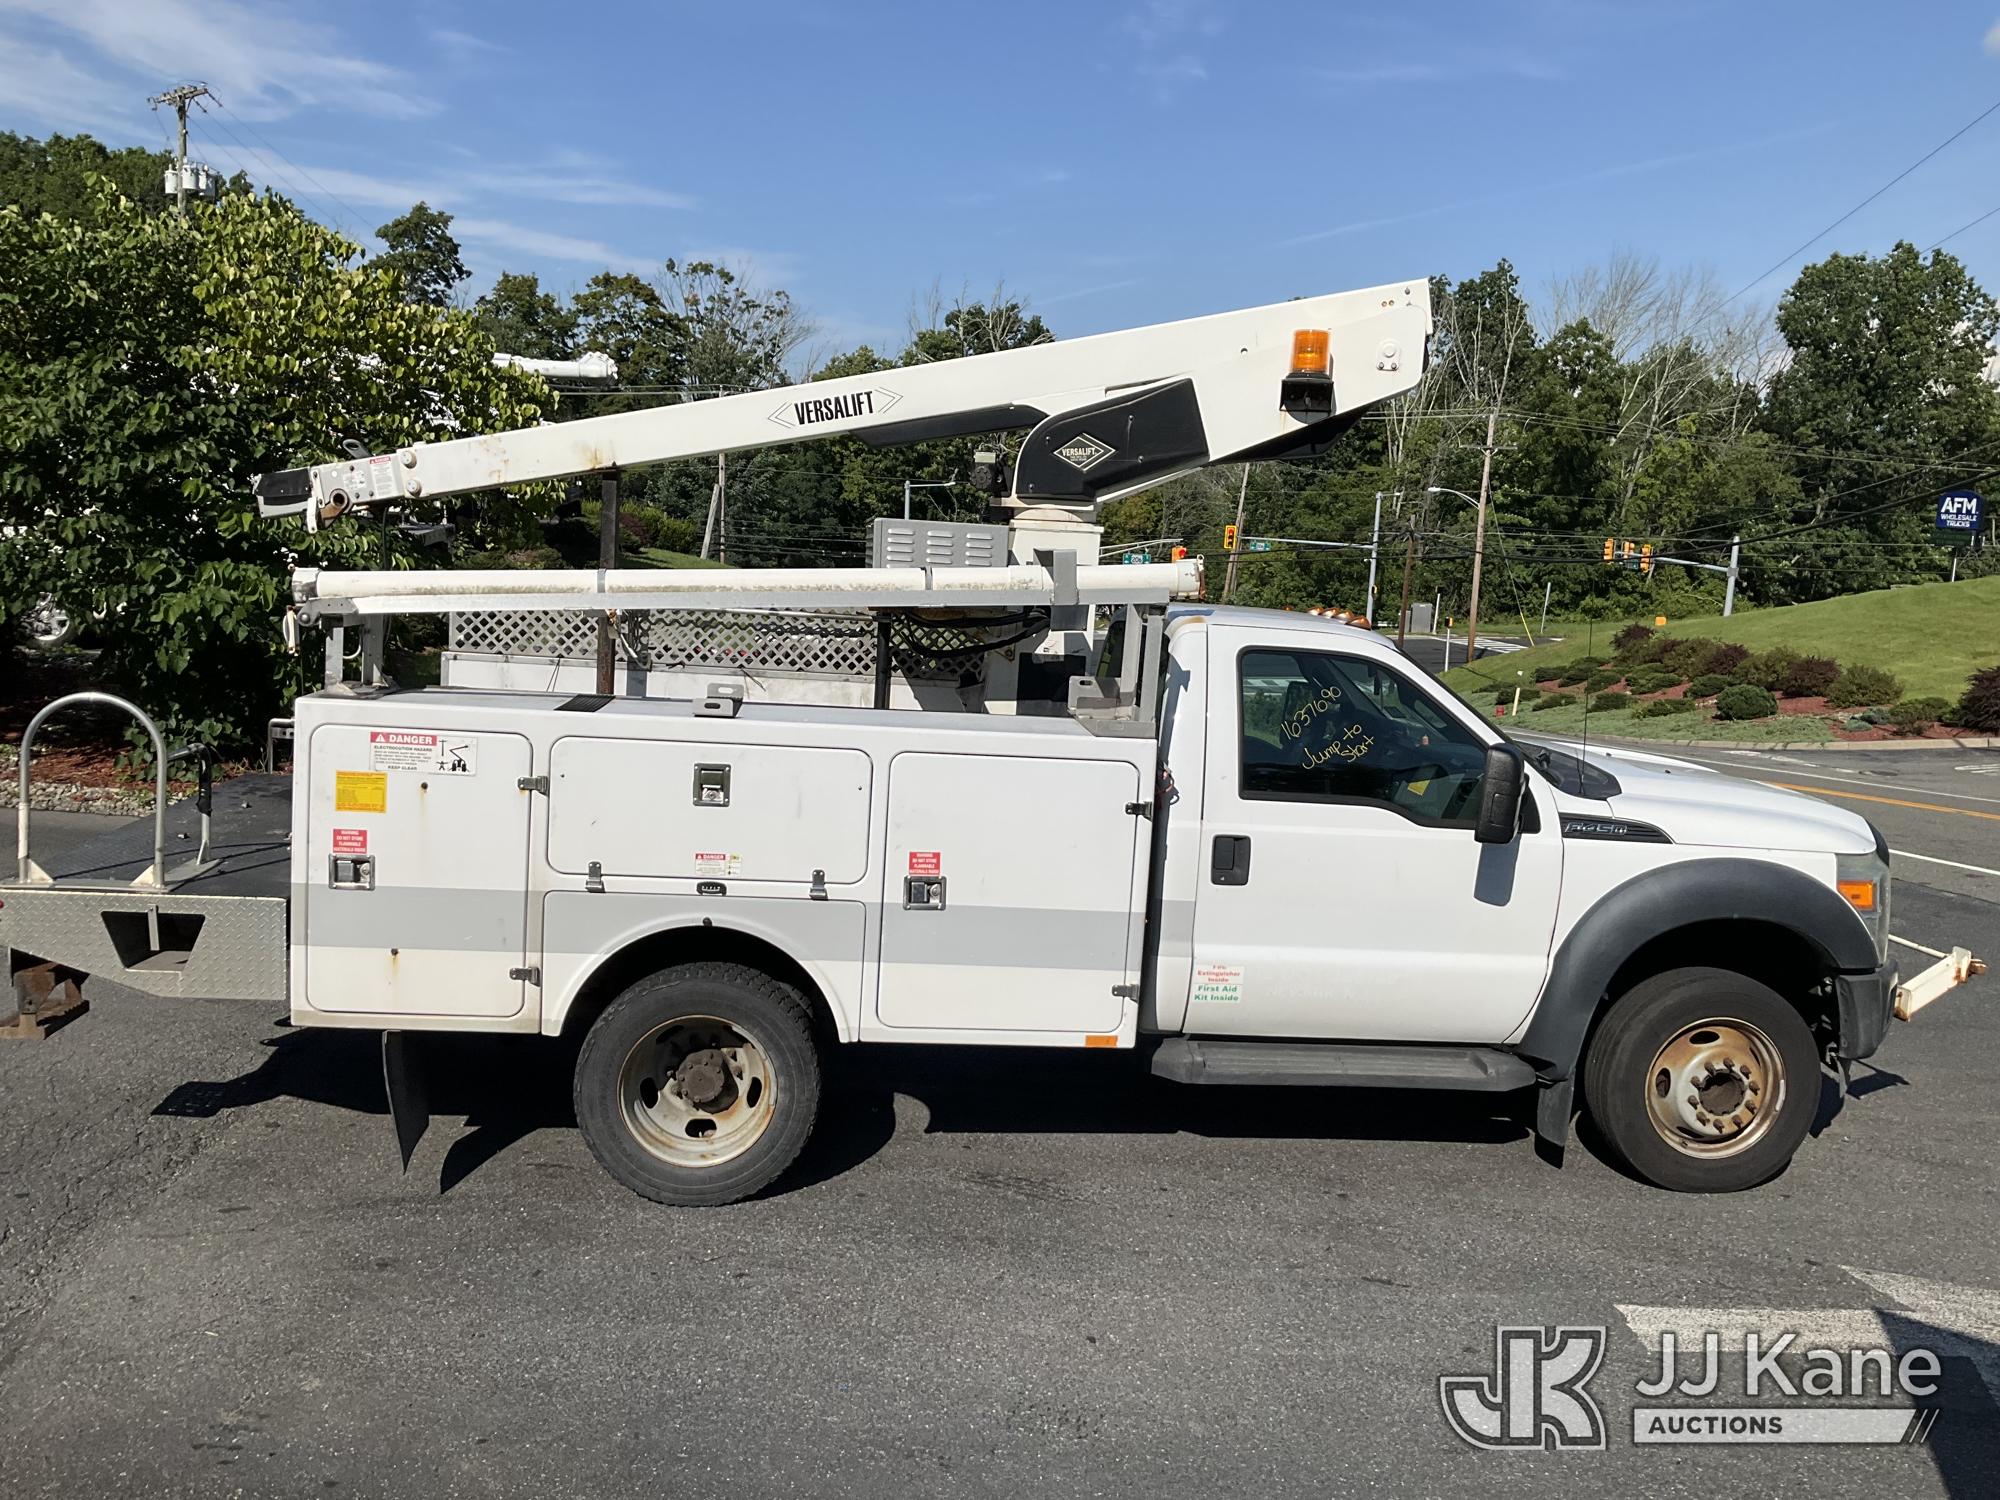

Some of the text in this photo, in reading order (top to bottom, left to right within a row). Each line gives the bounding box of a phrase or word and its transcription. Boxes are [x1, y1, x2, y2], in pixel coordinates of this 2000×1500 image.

[794, 391, 874, 425] VERSALIFT
[1061, 447, 1096, 457] VERSALIFT
[1940, 497, 1977, 514] AFM
[1940, 513, 1977, 522] WHOLESALE
[1946, 520, 1970, 528] TRUCKS
[389, 734, 433, 745] DANGER
[1302, 724, 1362, 769] Jump to
[1340, 735, 1374, 762] Start
